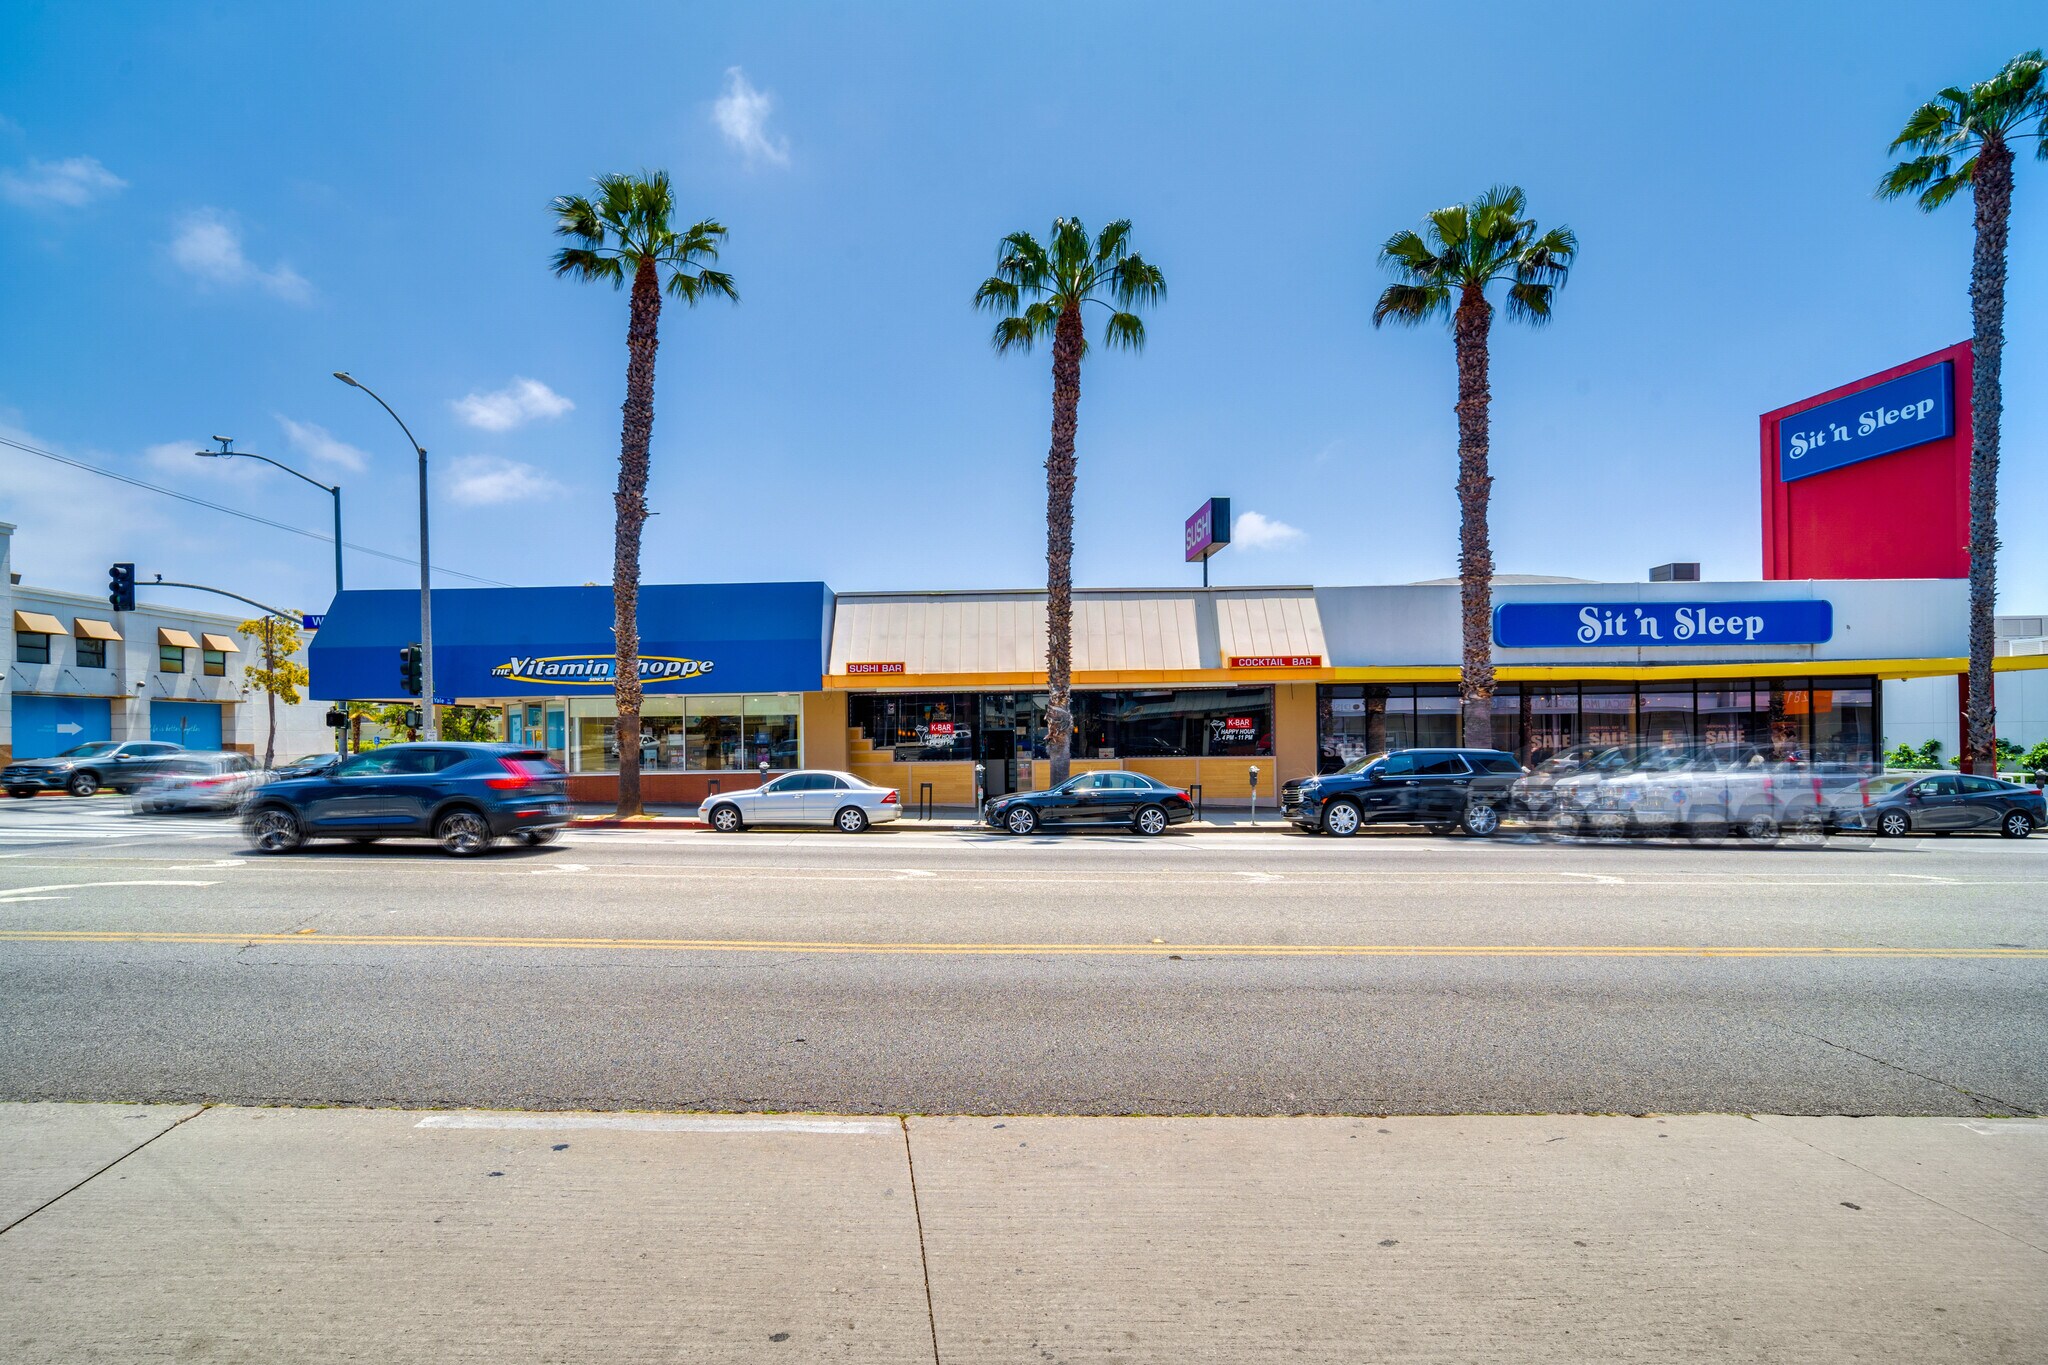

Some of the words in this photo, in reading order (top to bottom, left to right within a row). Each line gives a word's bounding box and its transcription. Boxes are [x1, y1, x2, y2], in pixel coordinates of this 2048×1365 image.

[1789, 430, 1827, 460] Sit
[1857, 398, 1935, 437] Sleep
[1186, 510, 1211, 551] SUSHI
[1577, 606, 1628, 644] Sit
[1673, 607, 1765, 641] Sleep
[491, 668, 511, 676] THE
[510, 657, 610, 676] Vitamin
[614, 660, 714, 678] hoppe
[849, 664, 879, 673] SUSHI
[881, 664, 902, 672] BAR
[1238, 658, 1286, 667] COCKTAIL
[1292, 658, 1313, 666] BAR
[1530, 734, 1571, 748] SALE
[1589, 731, 1628, 746] SALE
[1705, 730, 1745, 744] SALE
